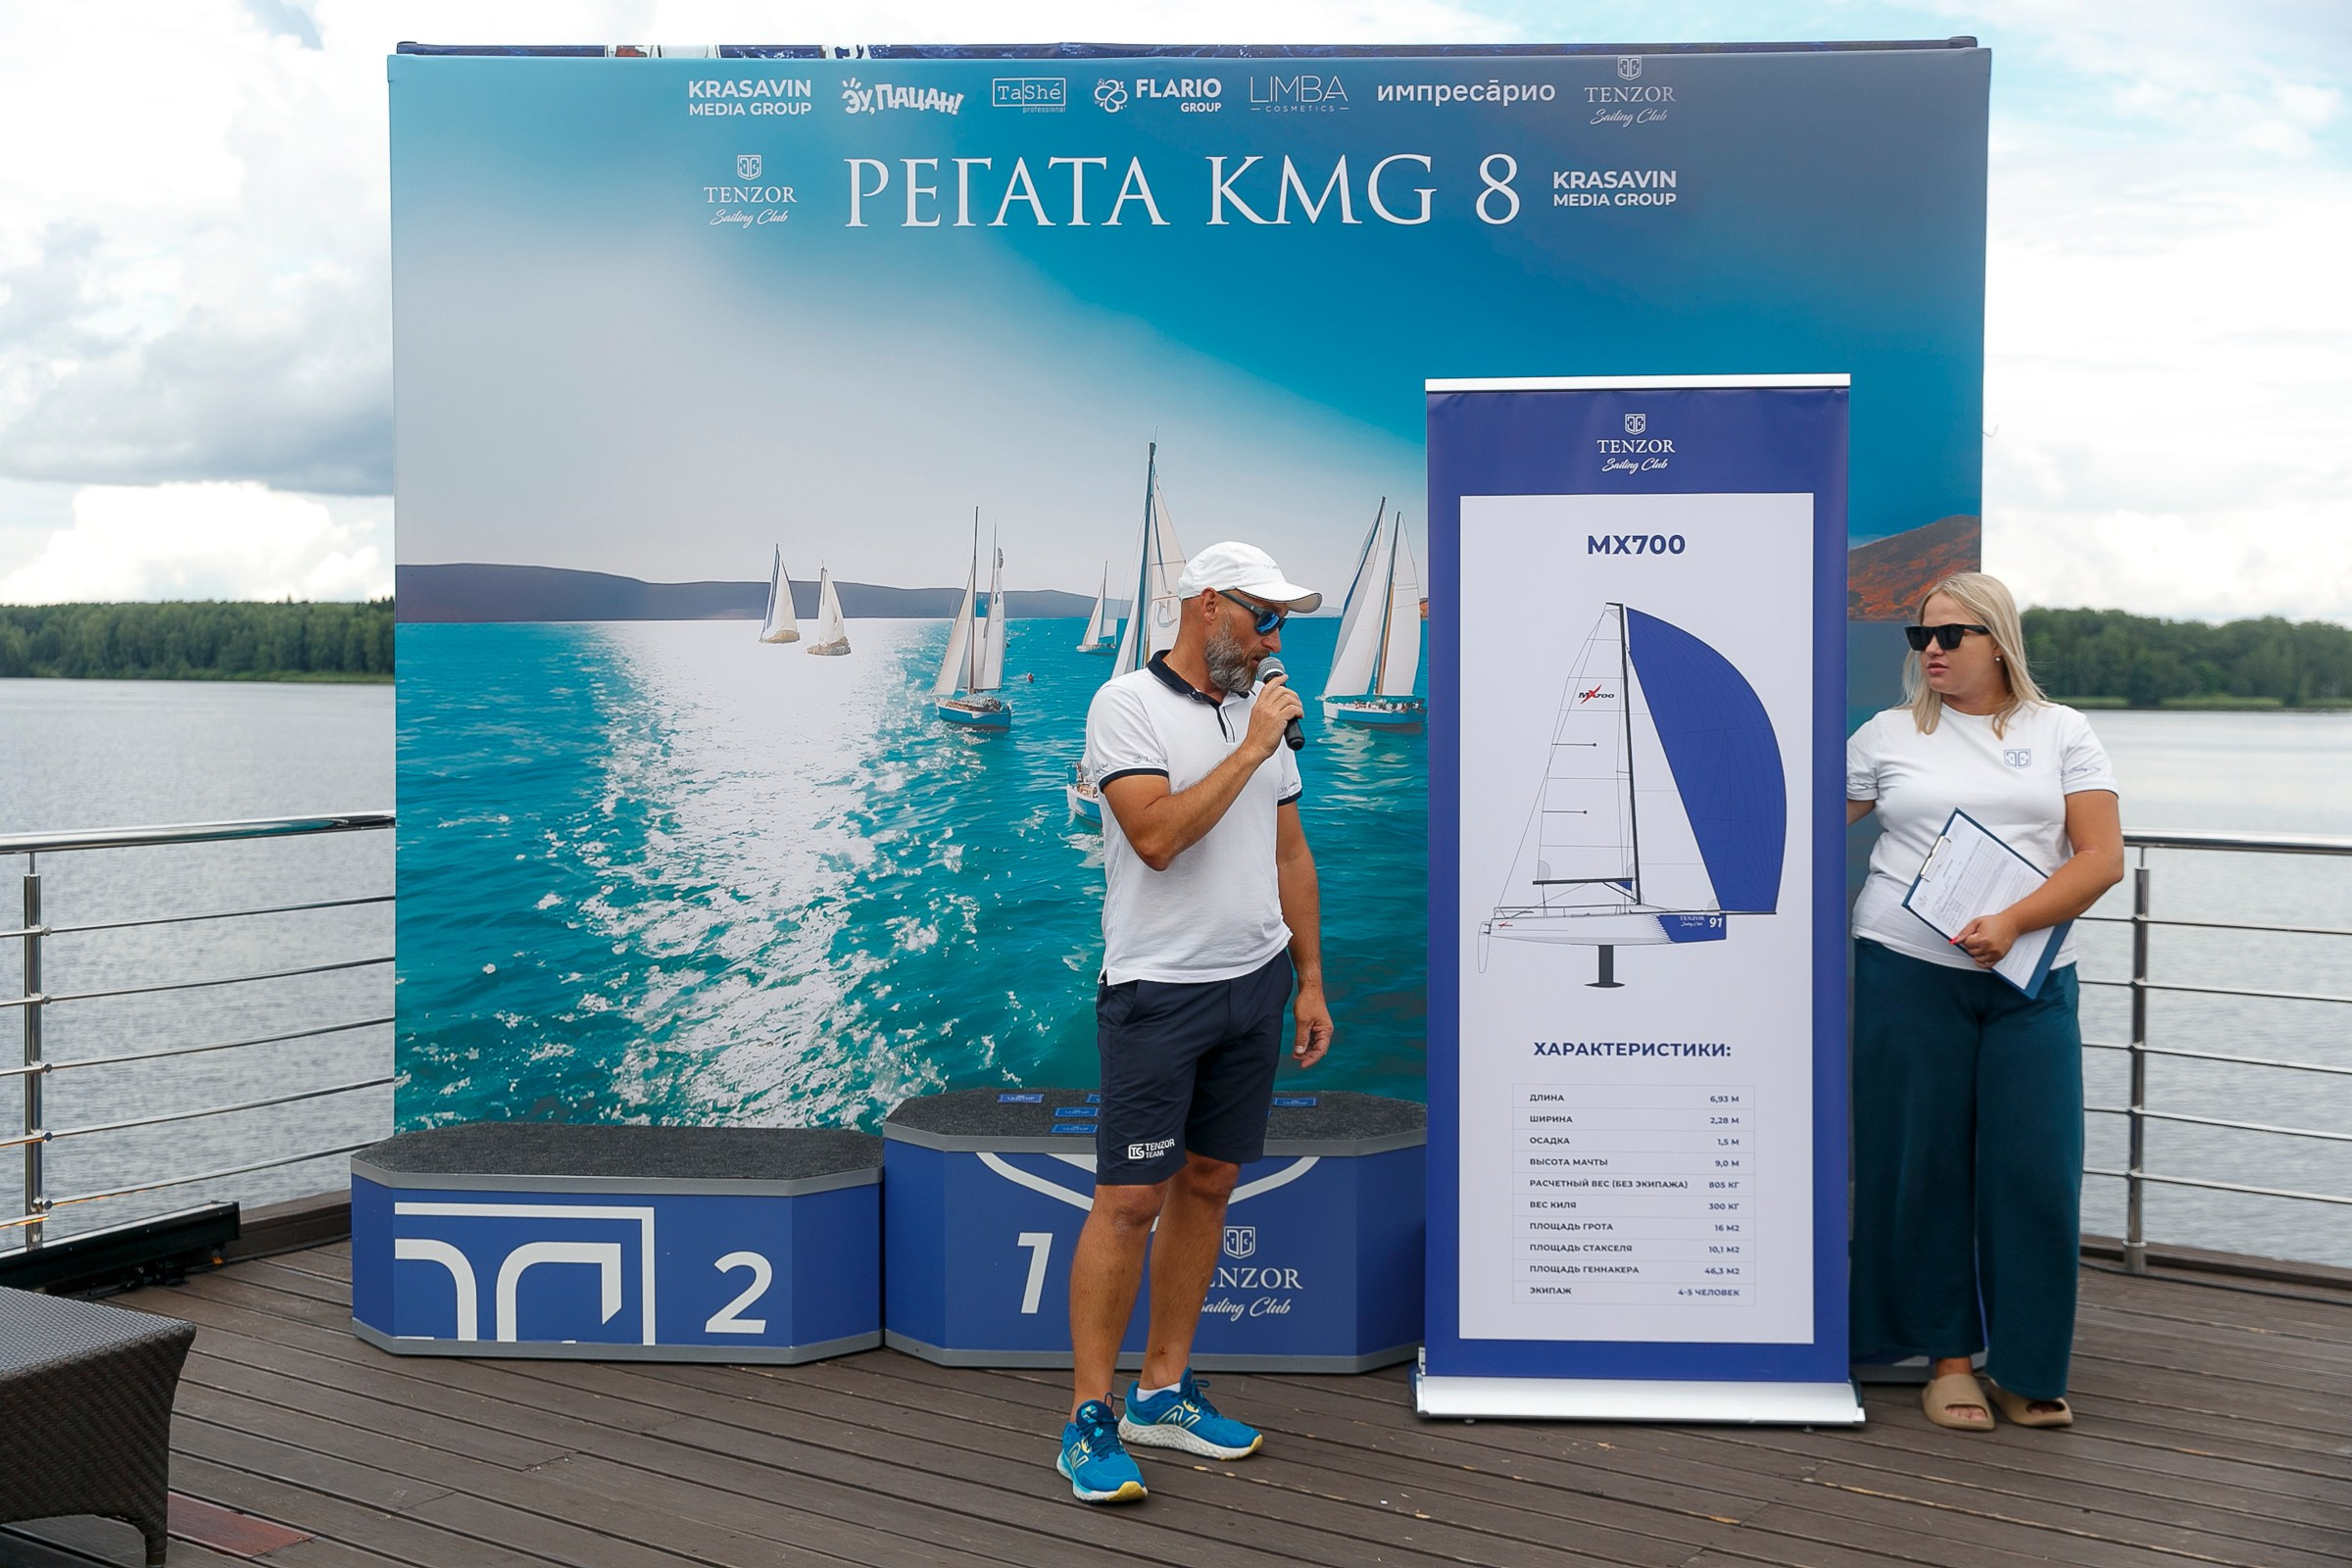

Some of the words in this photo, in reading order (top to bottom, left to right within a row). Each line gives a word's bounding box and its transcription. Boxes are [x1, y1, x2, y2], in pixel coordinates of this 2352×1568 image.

[688, 79, 811, 98] KRASAVIN
[998, 82, 1061, 100] TaShé
[1136, 78, 1222, 98] FLARIO
[1250, 75, 1348, 103] LIMBA
[1584, 86, 1676, 103] TENZOR
[689, 103, 745, 117] MEDIA
[749, 102, 811, 116] GROUP
[1180, 102, 1222, 113] GROUP
[1590, 108, 1634, 127] Sailing
[1637, 108, 1668, 123] Club
[1553, 171, 1677, 189] KRASAVIN
[704, 186, 798, 203] TENZOR
[844, 155, 1171, 228] РЕГАТА
[1204, 153, 1438, 226] KMG
[1475, 153, 1521, 226] 8
[1553, 193, 1611, 207] MEDIA
[1614, 192, 1677, 207] GROUP
[710, 209, 754, 229] Sailing
[757, 208, 789, 224] Club
[1596, 439, 1676, 454] TENZOR
[1601, 458, 1640, 474] Sailing
[1641, 457, 1668, 471] Club
[1587, 534, 1686, 555] MX700
[1709, 917, 1723, 928] 91
[1534, 1042, 1731, 1057] ХАРАКТЕРИСТИКИ:
[1145, 1138, 1175, 1152] TENZOR
[1146, 1150, 1164, 1158] TEAM
[1612, 1180, 1634, 1189] (БЕЗ
[1635, 1180, 1688, 1189] ЭКИПАЖА)
[1530, 1222, 1581, 1231] ПЛОЩАДЬ
[1530, 1244, 1581, 1252] ПЛОЩАДЬ
[1016, 1232, 1054, 1314] 1
[1530, 1265, 1581, 1274] ПЛОЩАДЬ
[1209, 1267, 1303, 1290] NZOR
[704, 1251, 773, 1335] 2
[1200, 1297, 1245, 1322] ailing
[1250, 1296, 1292, 1317] Club
